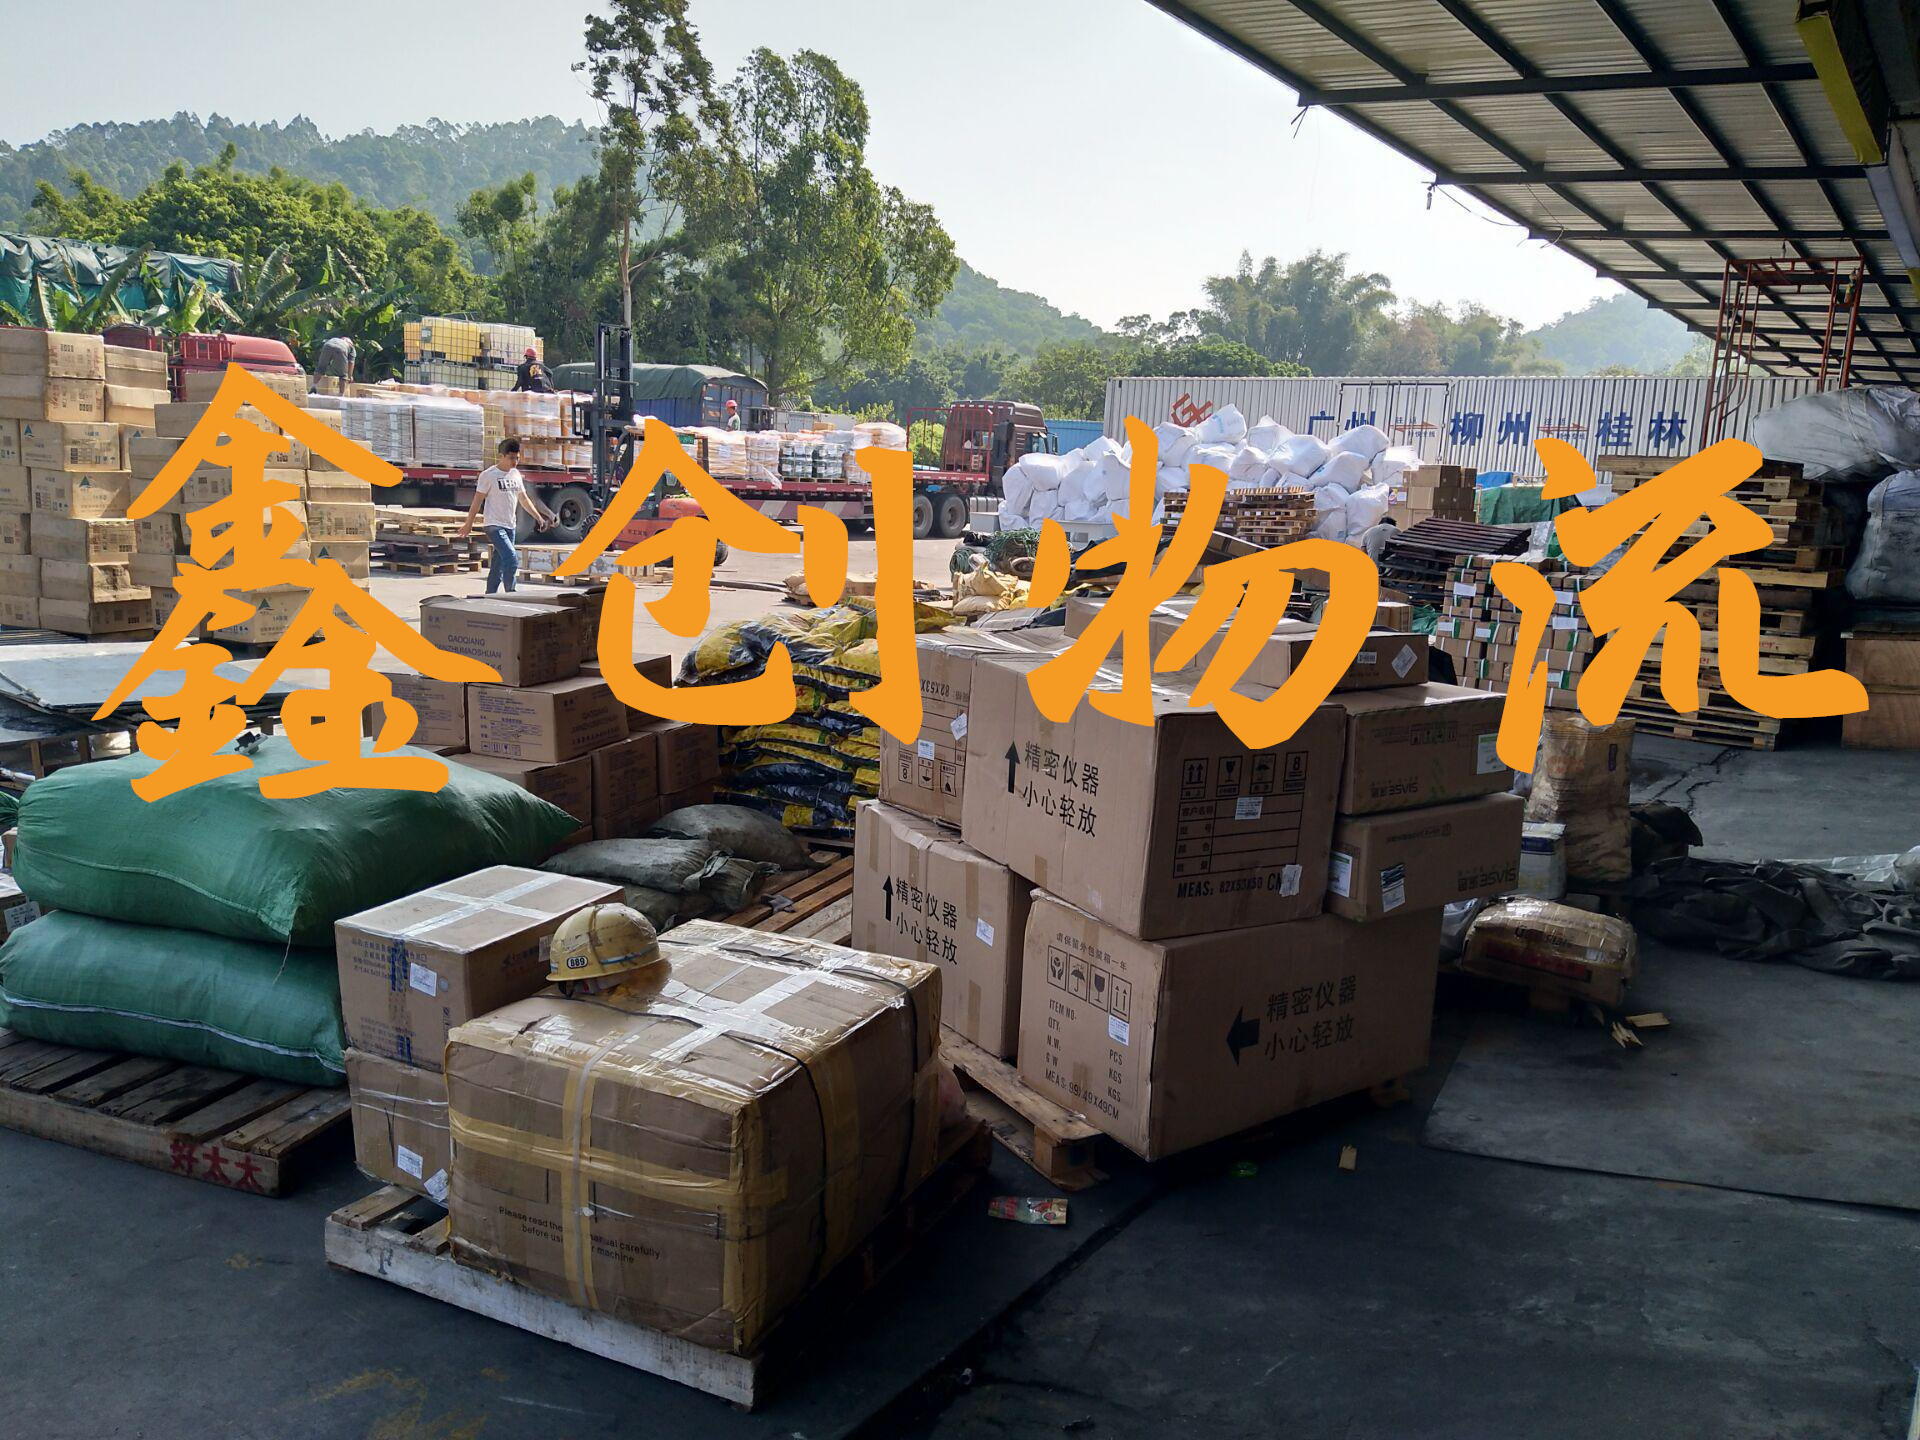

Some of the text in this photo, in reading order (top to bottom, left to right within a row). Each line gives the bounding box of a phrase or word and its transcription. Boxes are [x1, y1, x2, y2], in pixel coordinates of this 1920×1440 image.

[1449, 411, 1532, 447] 柳州
[1595, 411, 1688, 448] 桂林
[1025, 741, 1099, 797] 精密仪器
[1023, 780, 1097, 838] 小心轻放
[896, 876, 957, 931] 精密仪器
[896, 911, 957, 965] 小心轻放
[1049, 998, 1065, 1016] ITEM
[1266, 975, 1357, 1023] 精密仪器
[1109, 1049, 1123, 1066] PCS
[1265, 1013, 1355, 1061] 小心轻放
[1107, 1086, 1121, 1103] KGS
[1108, 1068, 1122, 1085] KGS
[499, 1206, 527, 1222] Please
[528, 1215, 548, 1228] read
[619, 1239, 661, 1260] carefully
[522, 1225, 549, 1240] before
[596, 1247, 635, 1264] machine
